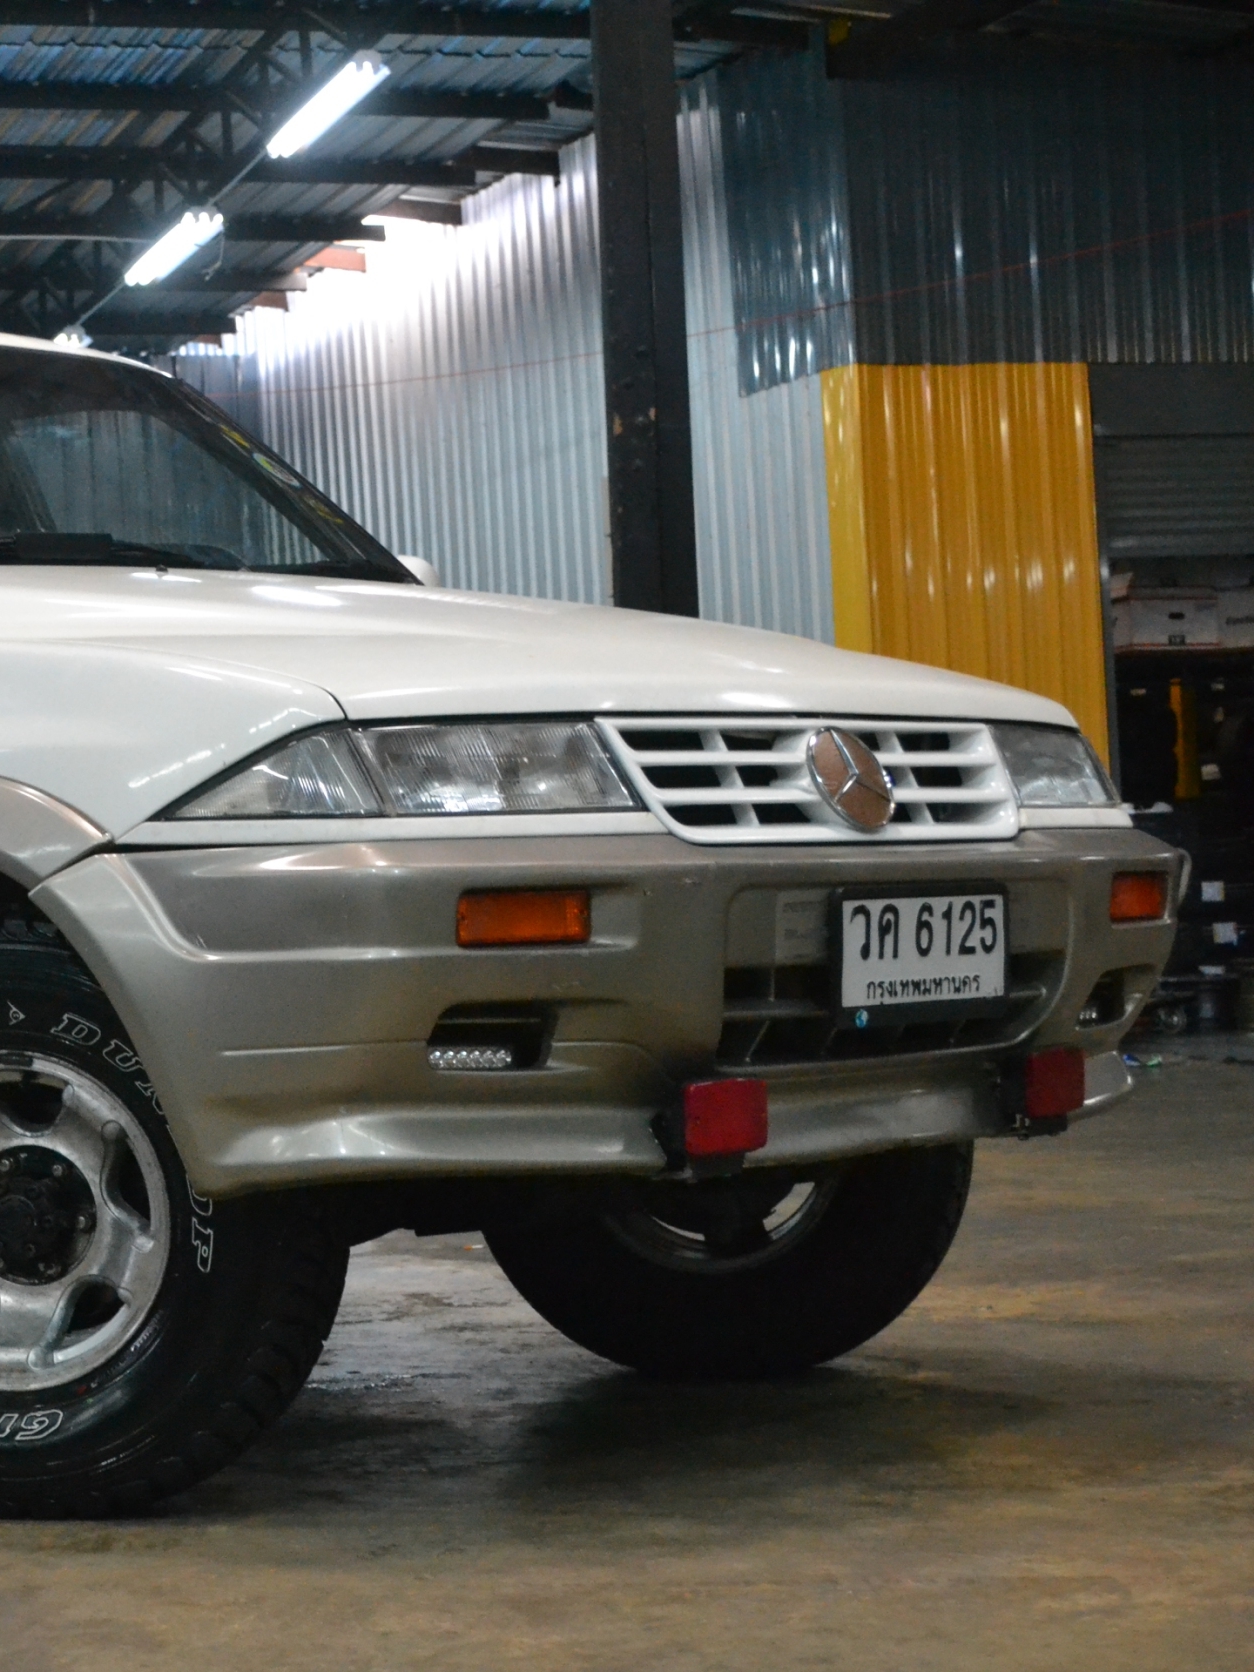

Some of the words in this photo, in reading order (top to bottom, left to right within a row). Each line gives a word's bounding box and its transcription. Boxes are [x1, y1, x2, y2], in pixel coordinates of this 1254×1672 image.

[915, 899, 997, 957] 6125
[867, 974, 981, 1005] กรุงเทพมหานคร
